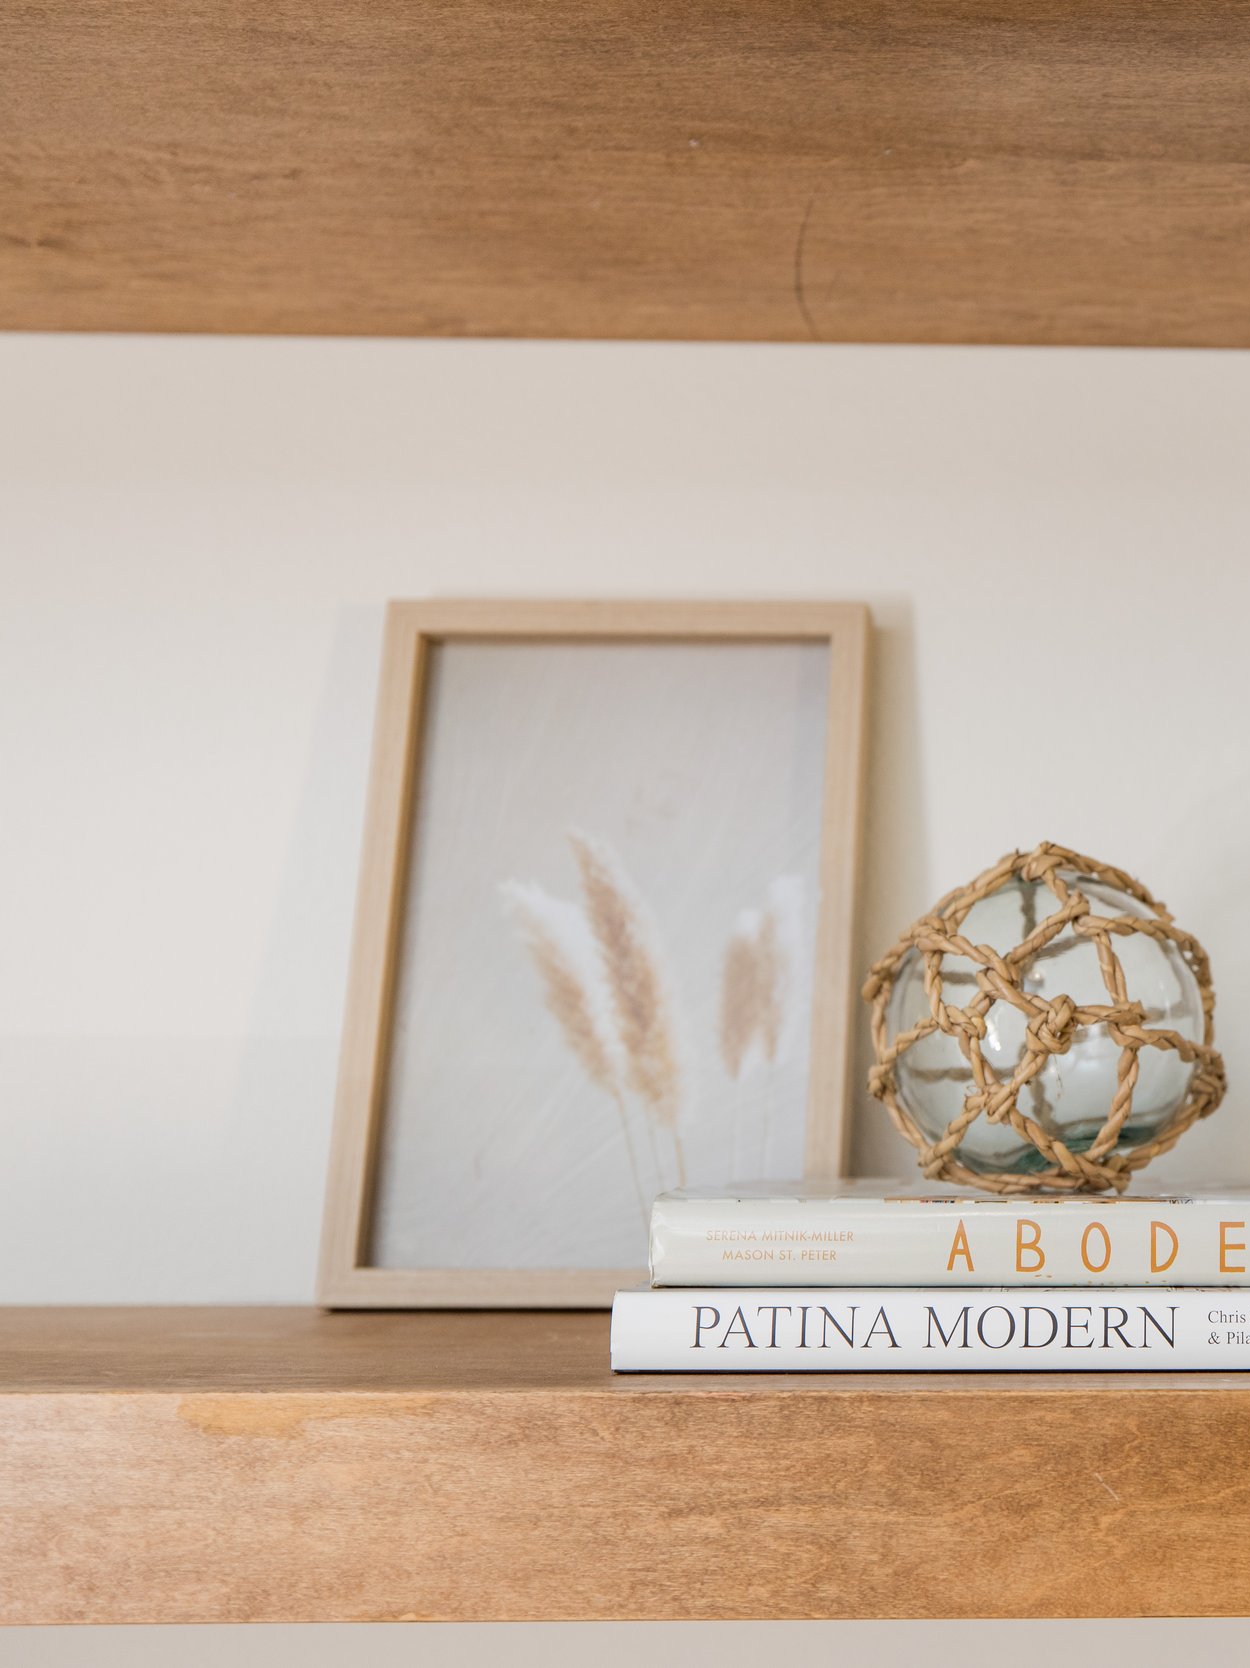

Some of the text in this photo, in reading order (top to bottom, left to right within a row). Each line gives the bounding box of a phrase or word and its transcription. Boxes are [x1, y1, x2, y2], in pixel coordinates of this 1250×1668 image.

[706, 1230, 854, 1242] SERENA MITNIK-MILLER
[947, 1219, 1246, 1273] ABODE
[722, 1249, 837, 1261] MASON ST. PETER
[1208, 1310, 1246, 1324] Chris
[690, 1305, 1180, 1349] PATINA MODERN
[1208, 1331, 1221, 1345] &
